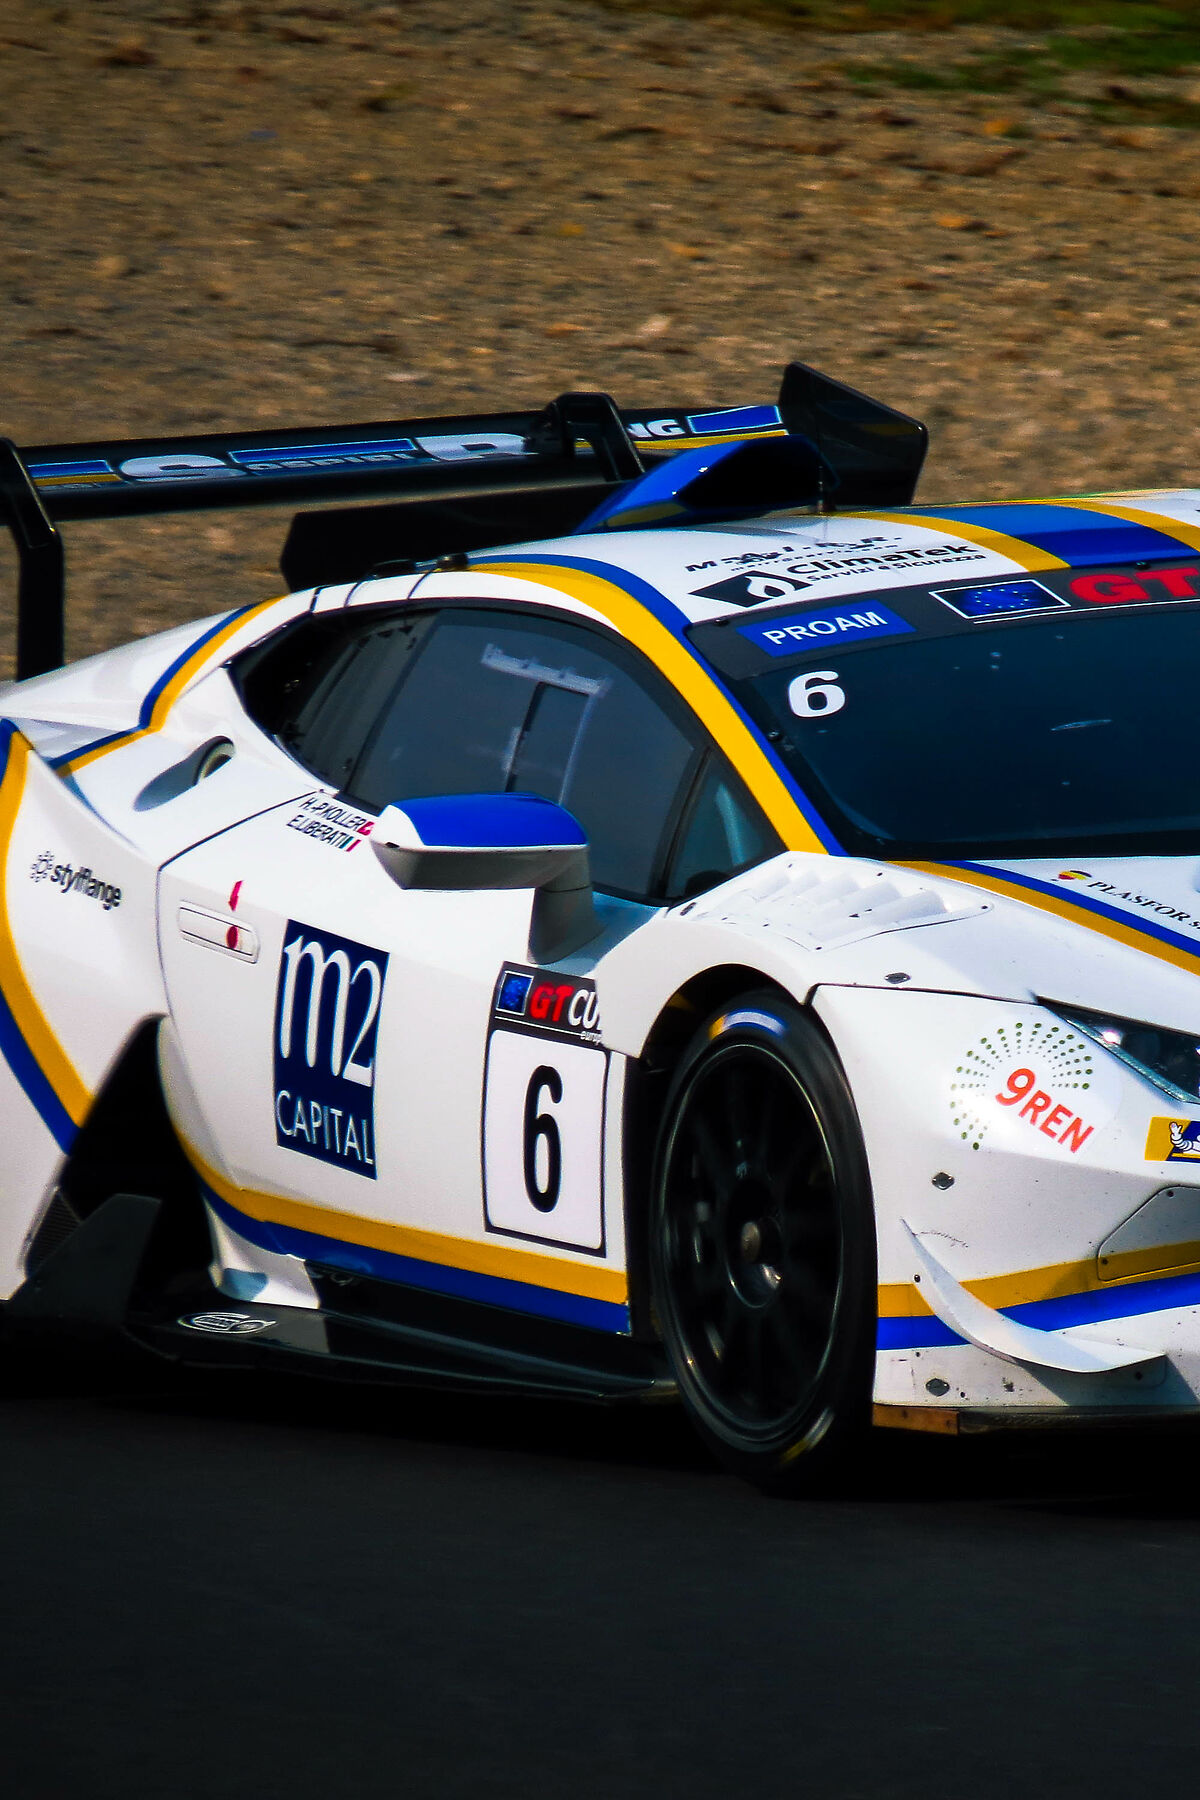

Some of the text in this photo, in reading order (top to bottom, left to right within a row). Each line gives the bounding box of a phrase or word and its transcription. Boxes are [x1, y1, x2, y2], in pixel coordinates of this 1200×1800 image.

[787, 545, 979, 575] ClimaTek
[806, 566, 874, 582] Servizi
[877, 563, 891, 571] e
[1069, 566, 1200, 601] GT
[761, 611, 889, 645] PROAM
[788, 670, 846, 718] 6
[1087, 881, 1192, 922] PLASFOR
[281, 933, 382, 1089] m2
[529, 981, 602, 1031] GT CU
[278, 1089, 374, 1166] CAPITAL
[995, 1068, 1095, 1153] 9REN
[523, 1065, 564, 1213] 6
